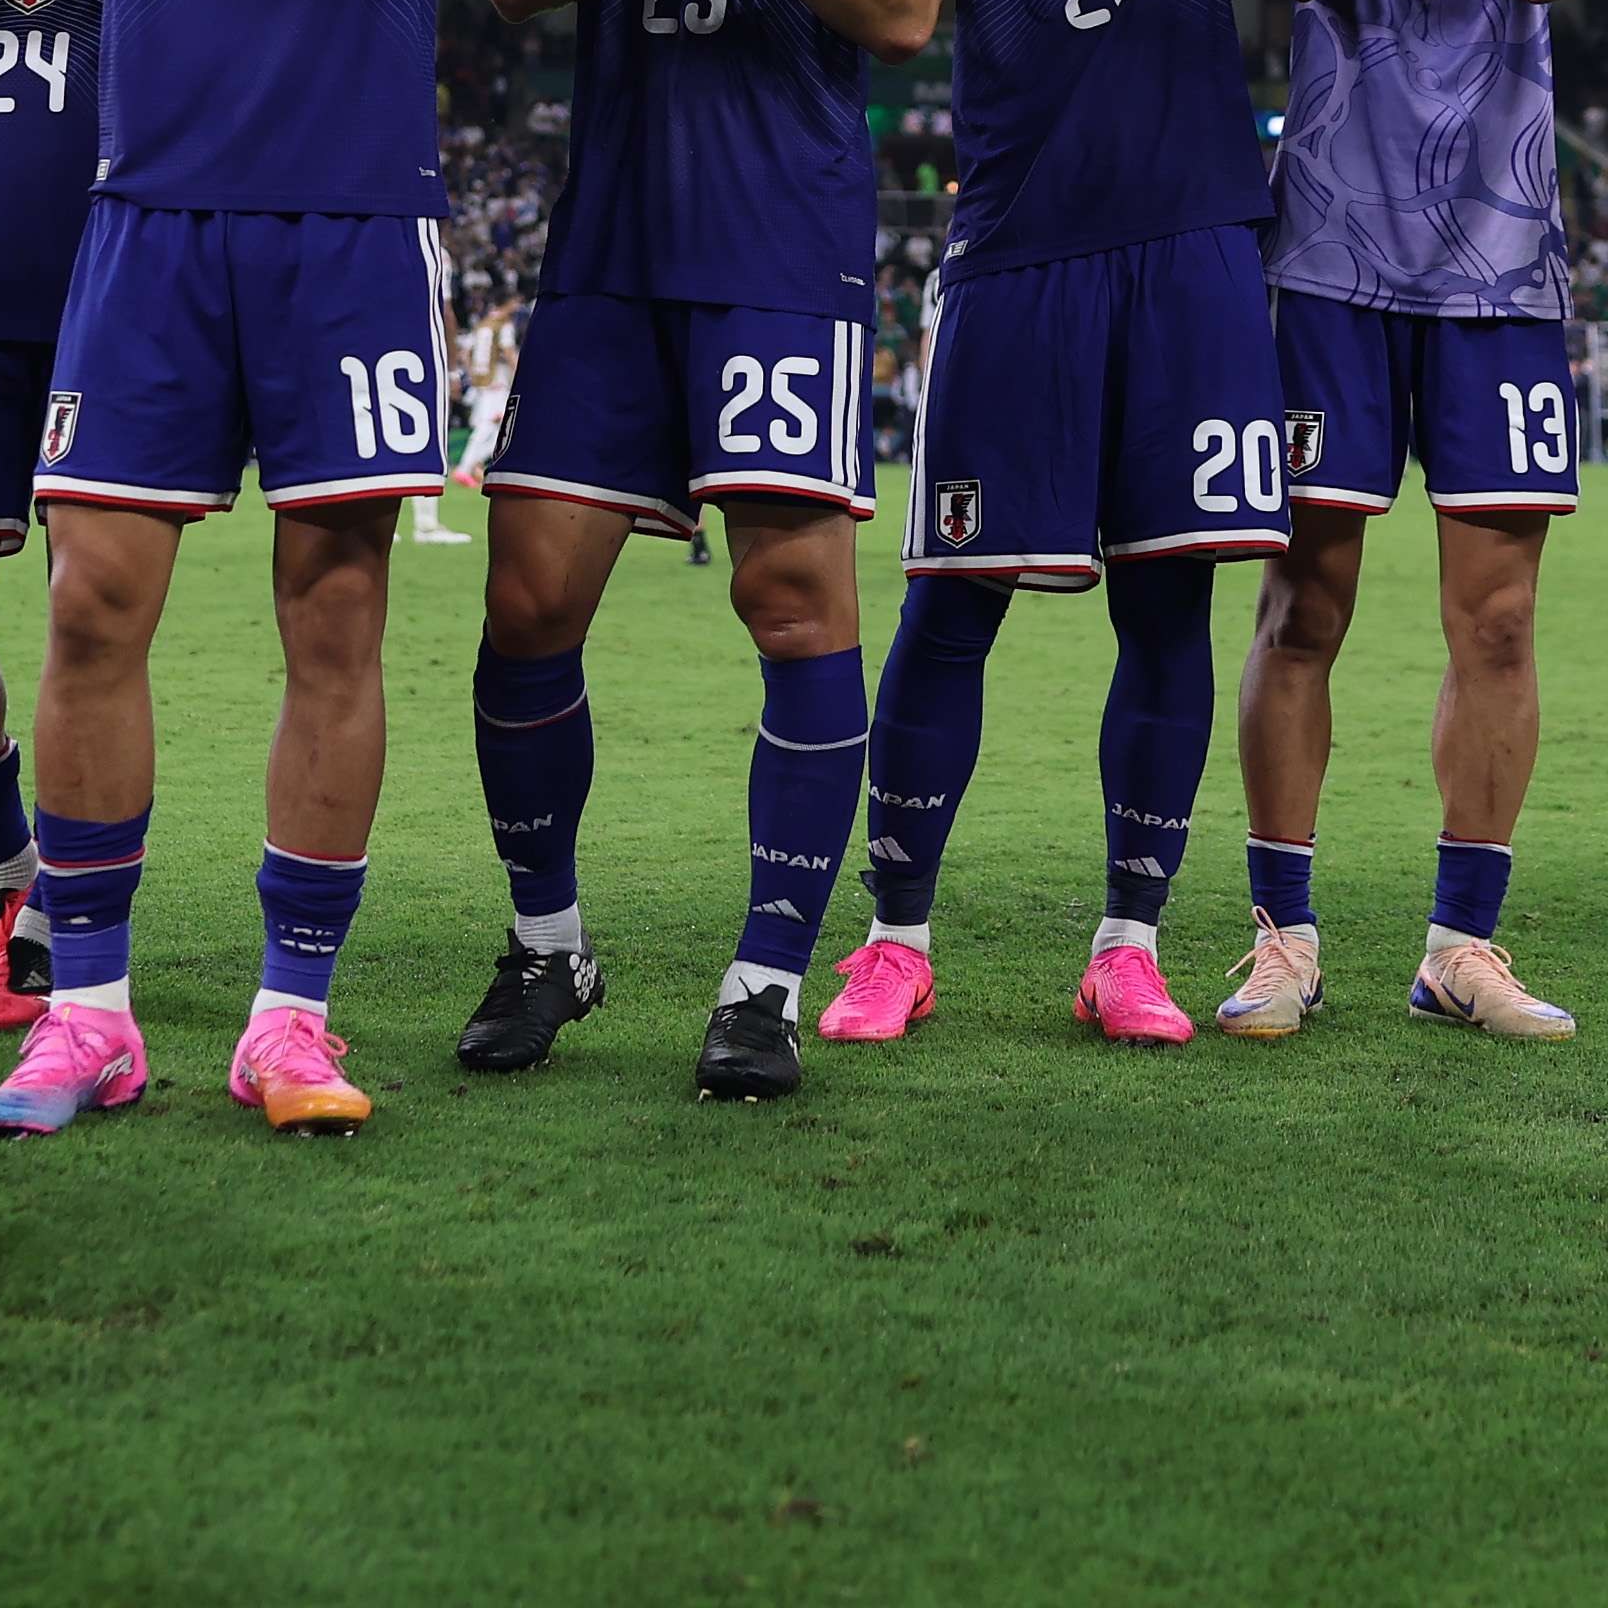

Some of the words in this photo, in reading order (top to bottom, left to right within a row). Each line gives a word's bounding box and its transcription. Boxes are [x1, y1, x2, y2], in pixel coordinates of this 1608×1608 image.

[340, 350, 430, 459] 16
[718, 355, 820, 455] 25
[1499, 382, 1568, 474] 13
[1193, 419, 1283, 513] 20
[493, 813, 553, 834] PAN
[868, 782, 946, 810] APAN
[1111, 802, 1191, 831] JAPAN
